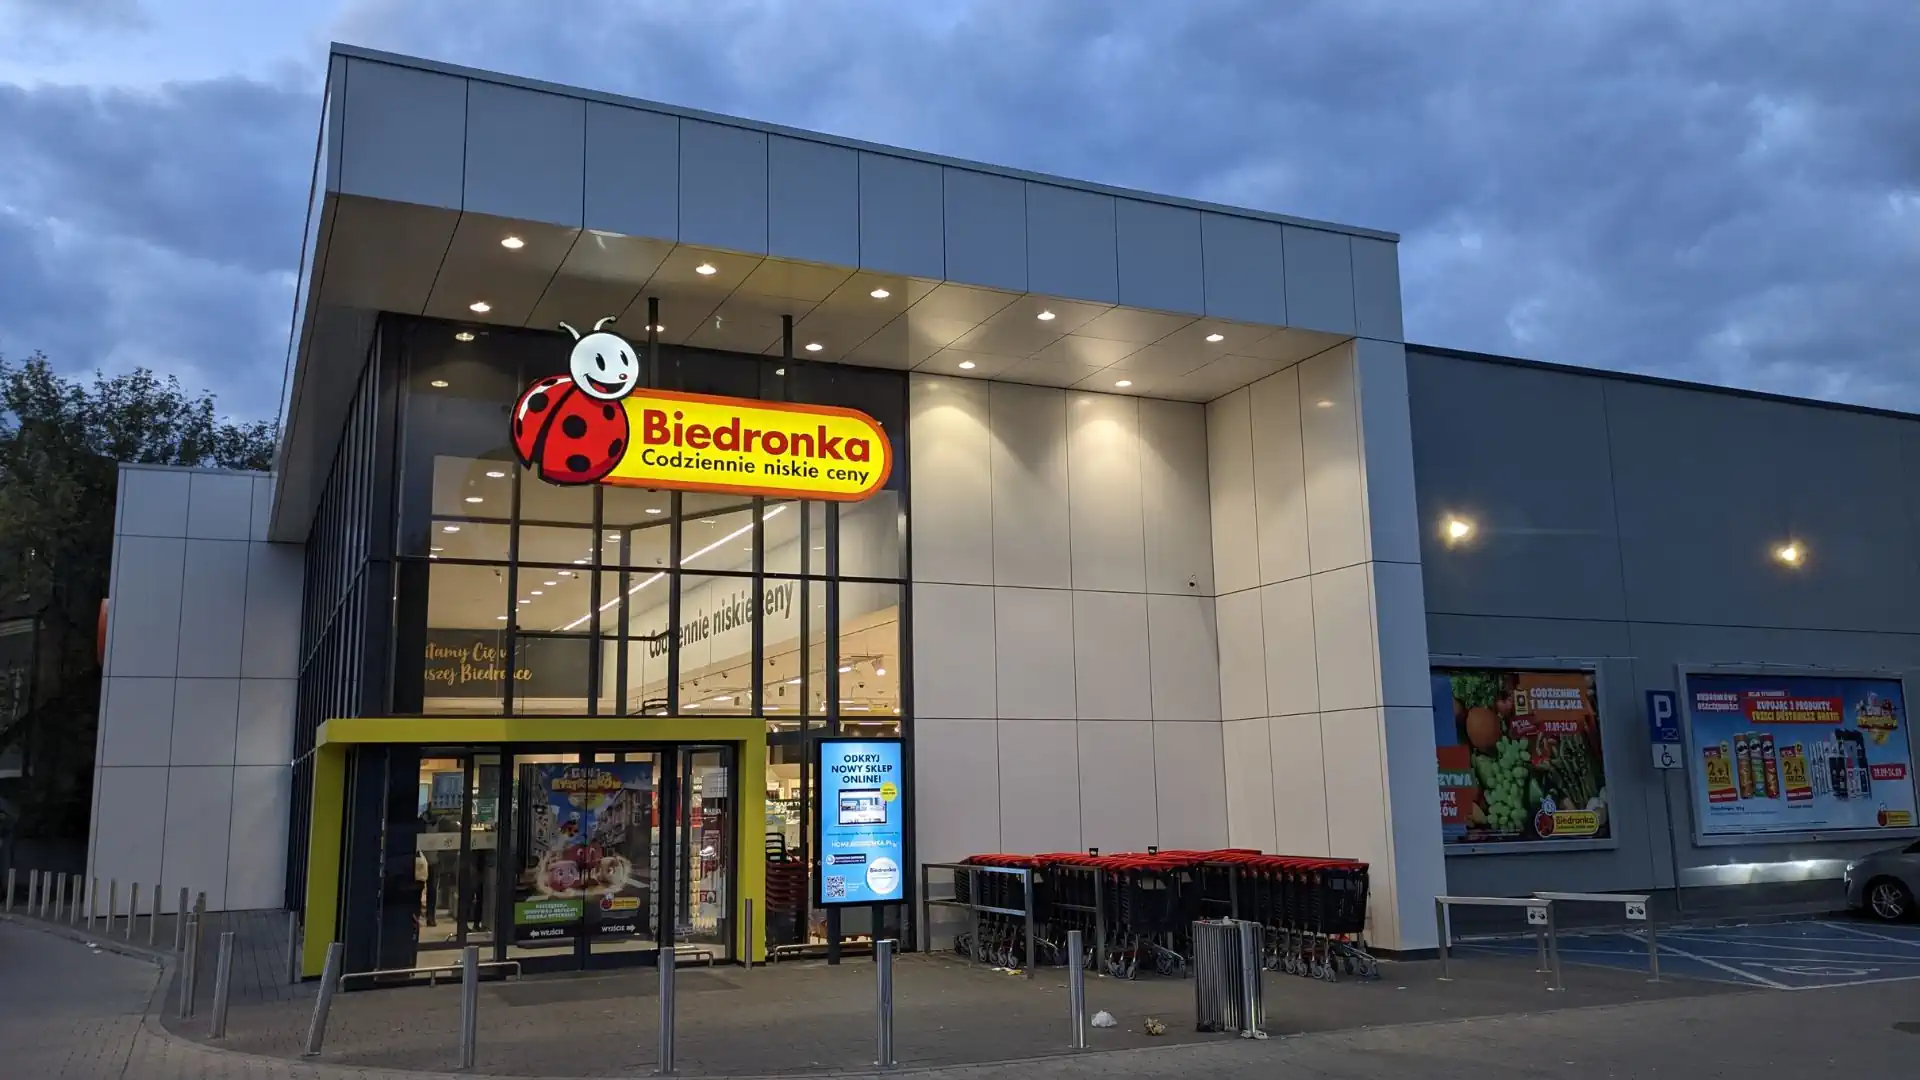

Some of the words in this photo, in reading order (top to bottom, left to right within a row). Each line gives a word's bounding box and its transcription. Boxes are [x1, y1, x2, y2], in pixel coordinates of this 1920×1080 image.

[643, 409, 870, 463] Biedronka
[641, 449, 756, 474] Codziennie
[764, 460, 819, 478] niskie
[827, 467, 869, 485] ceny
[649, 608, 709, 658] Codennie
[763, 581, 793, 619] eny
[473, 642, 497, 661] Cię
[1537, 699, 1584, 710] NAKLEJKA
[1653, 694, 1672, 728] P
[843, 754, 880, 763] ODKRYJ
[831, 765, 863, 773] NOWY
[865, 764, 893, 773] SKLEP
[1707, 760, 1728, 776] 2+1
[1784, 760, 1804, 775] 2+1
[842, 775, 881, 784] ONLINE!
[1437, 773, 1472, 786] ZYWA
[1556, 816, 1594, 825] Biedronka
[602, 924, 625, 933] WYJŚCIE
